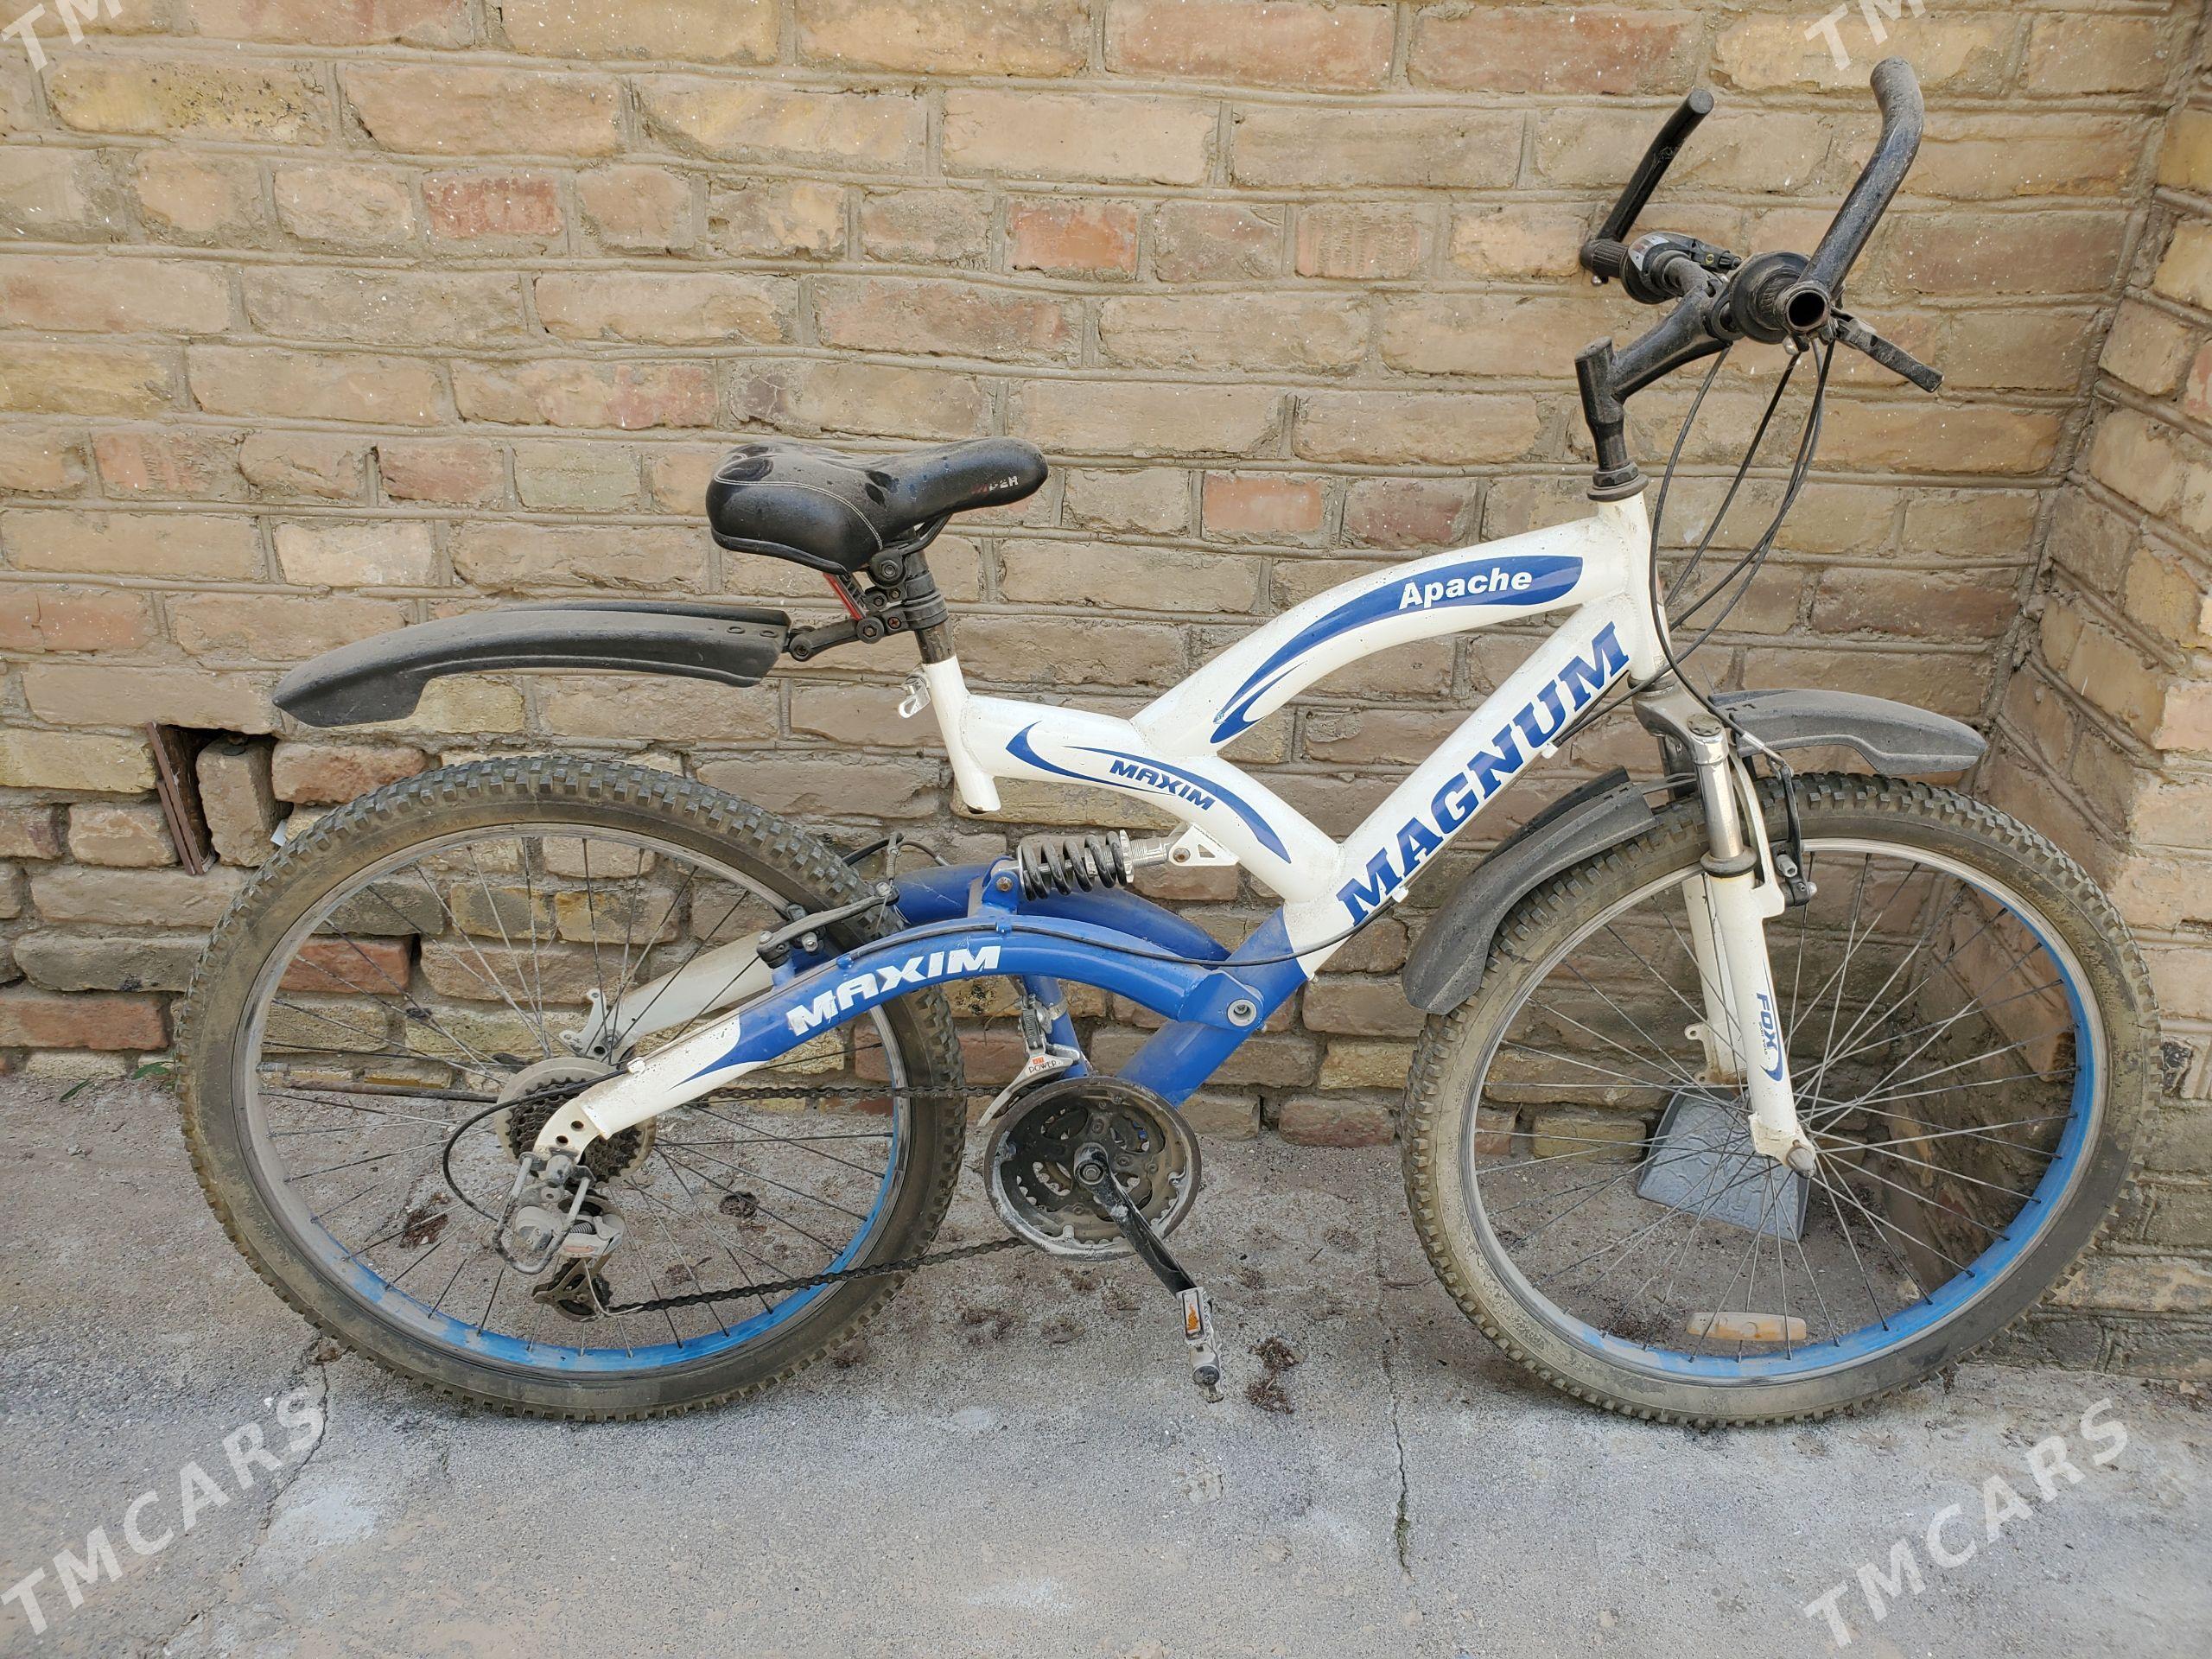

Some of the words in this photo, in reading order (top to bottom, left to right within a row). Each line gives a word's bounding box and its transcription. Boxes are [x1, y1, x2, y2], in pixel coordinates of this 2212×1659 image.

[1397, 567, 1533, 610] Apache
[1109, 760, 1217, 811] MAXIM
[1336, 621, 1630, 927] MAGNUM
[785, 946, 1001, 1037] MAXIM
[1756, 992, 1778, 1052] FOX
[1028, 1059, 1057, 1073] POWER
